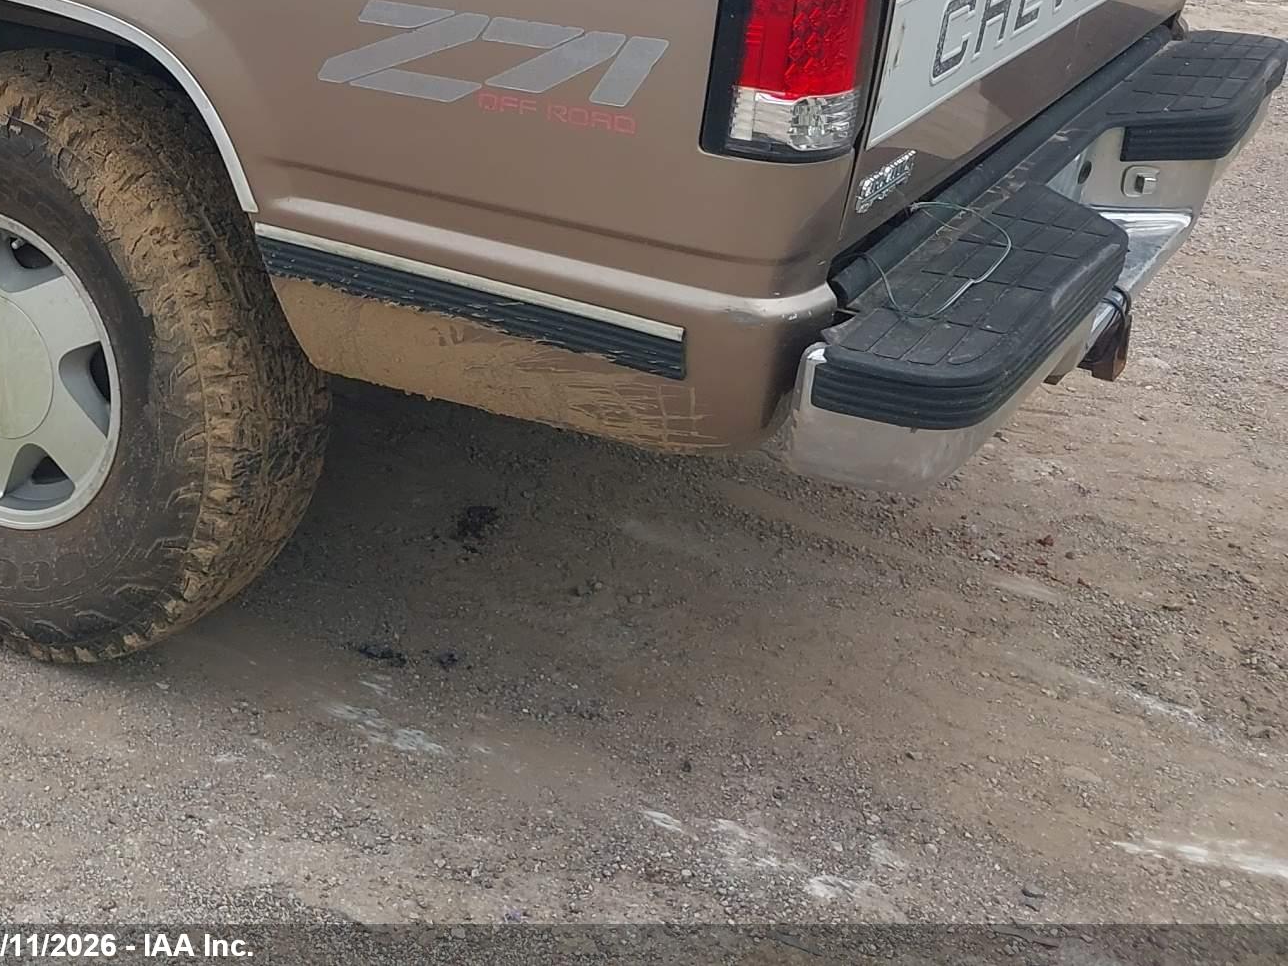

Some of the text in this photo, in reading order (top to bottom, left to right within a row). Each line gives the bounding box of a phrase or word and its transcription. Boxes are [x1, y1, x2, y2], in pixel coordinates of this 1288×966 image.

[318, 0, 669, 107] Z71
[476, 92, 637, 135] OFF ROAD
